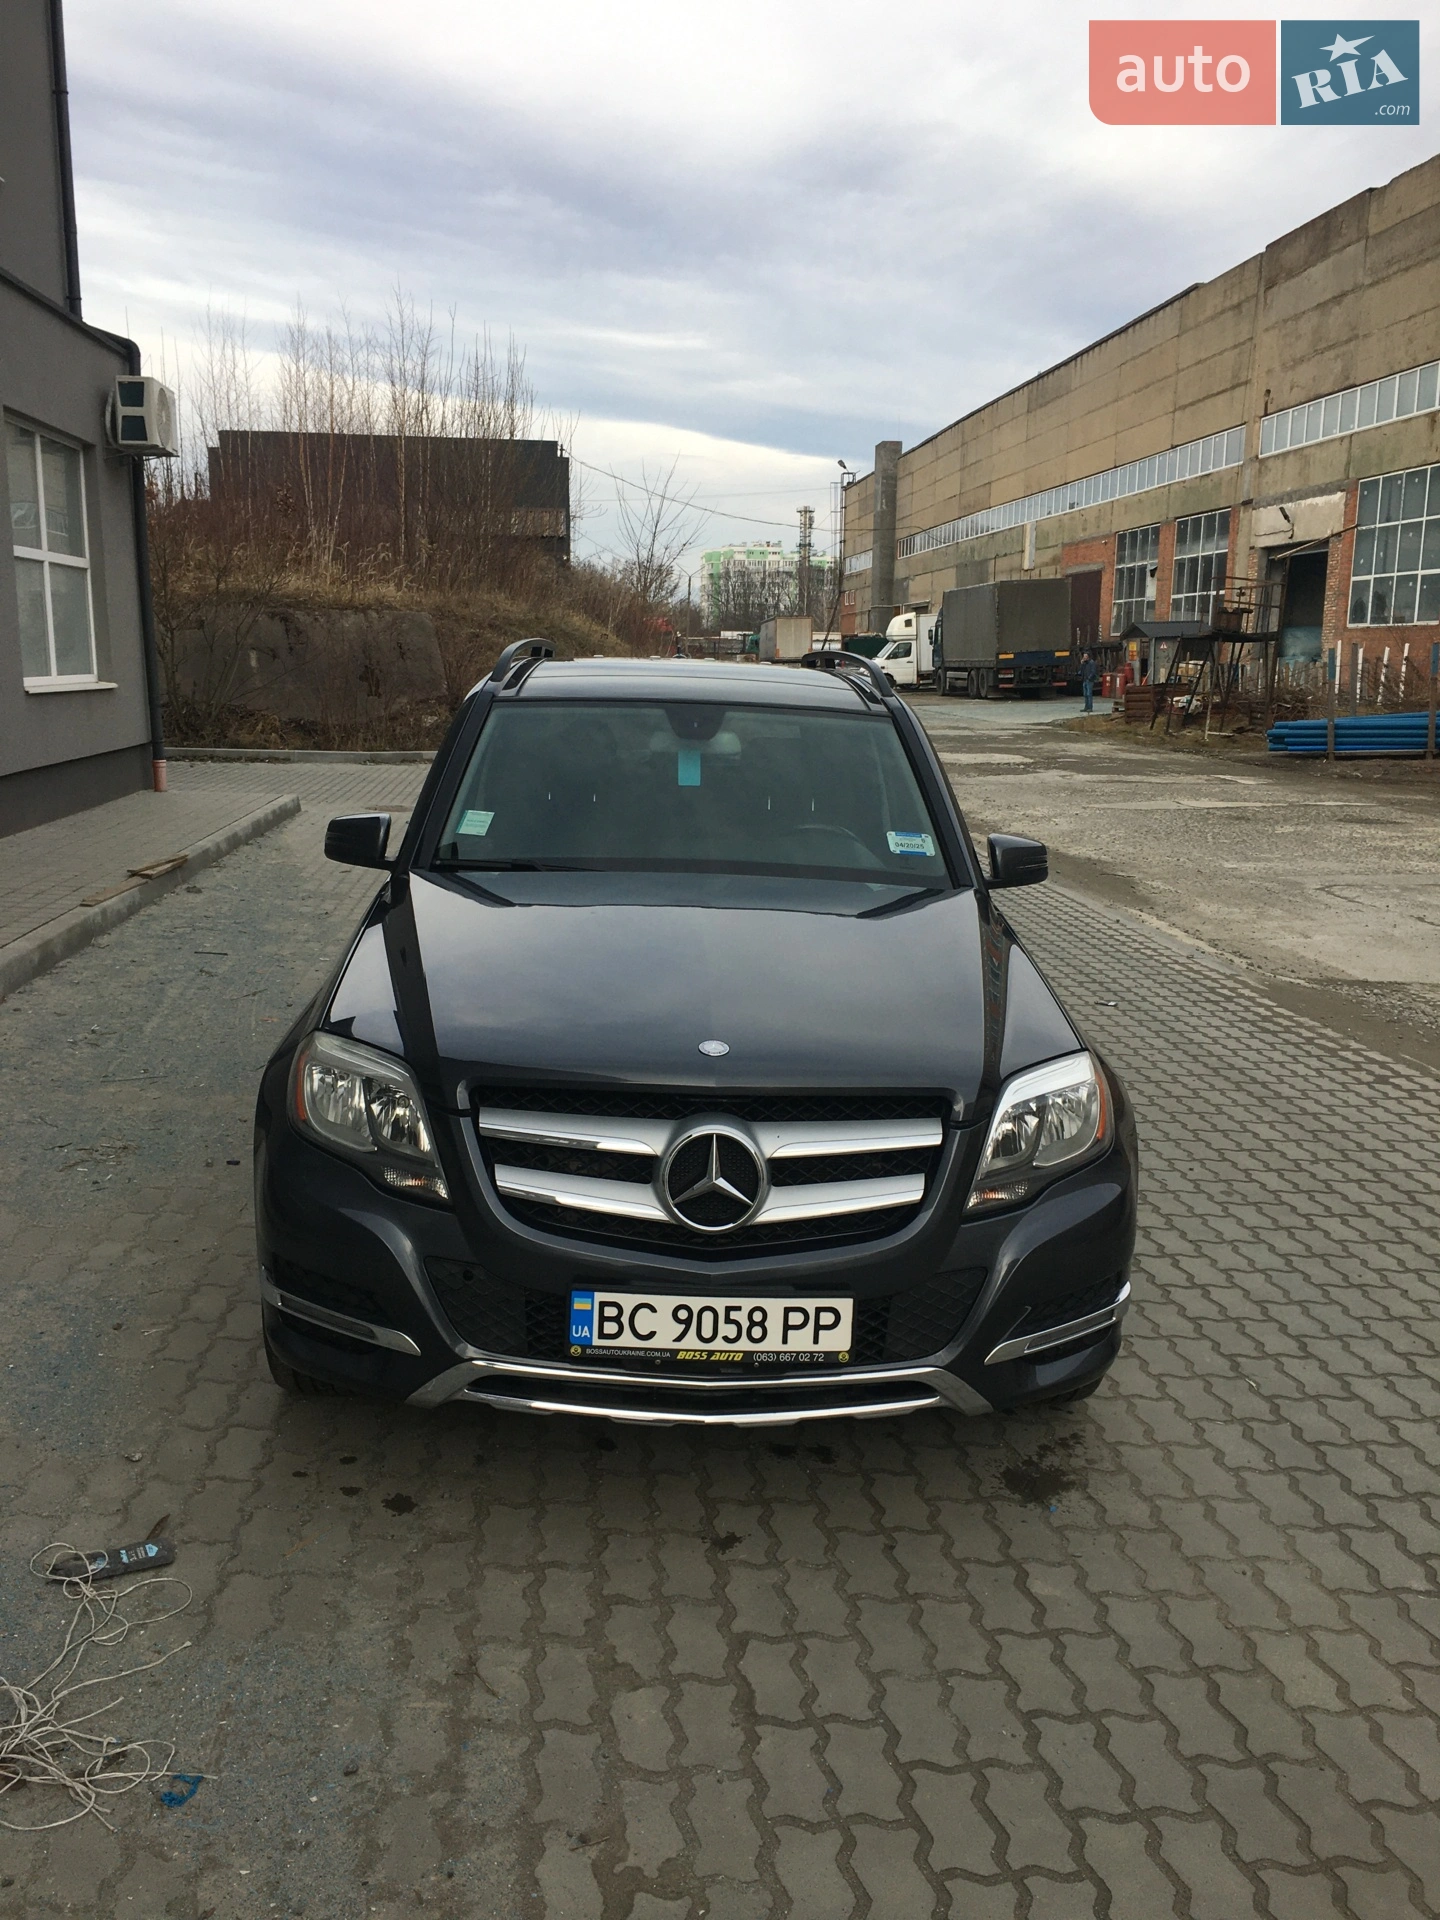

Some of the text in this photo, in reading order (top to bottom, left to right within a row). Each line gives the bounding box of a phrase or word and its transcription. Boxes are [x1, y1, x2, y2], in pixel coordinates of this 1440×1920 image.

[597, 1300, 842, 1345] BC 9058 PP
[572, 1325, 591, 1338] UA
[586, 1348, 671, 1358] BOSSAUTOUKRAINE.COM.UA
[676, 1351, 744, 1361] BOSS AUTO
[753, 1352, 825, 1362] (063) 667 02 72
